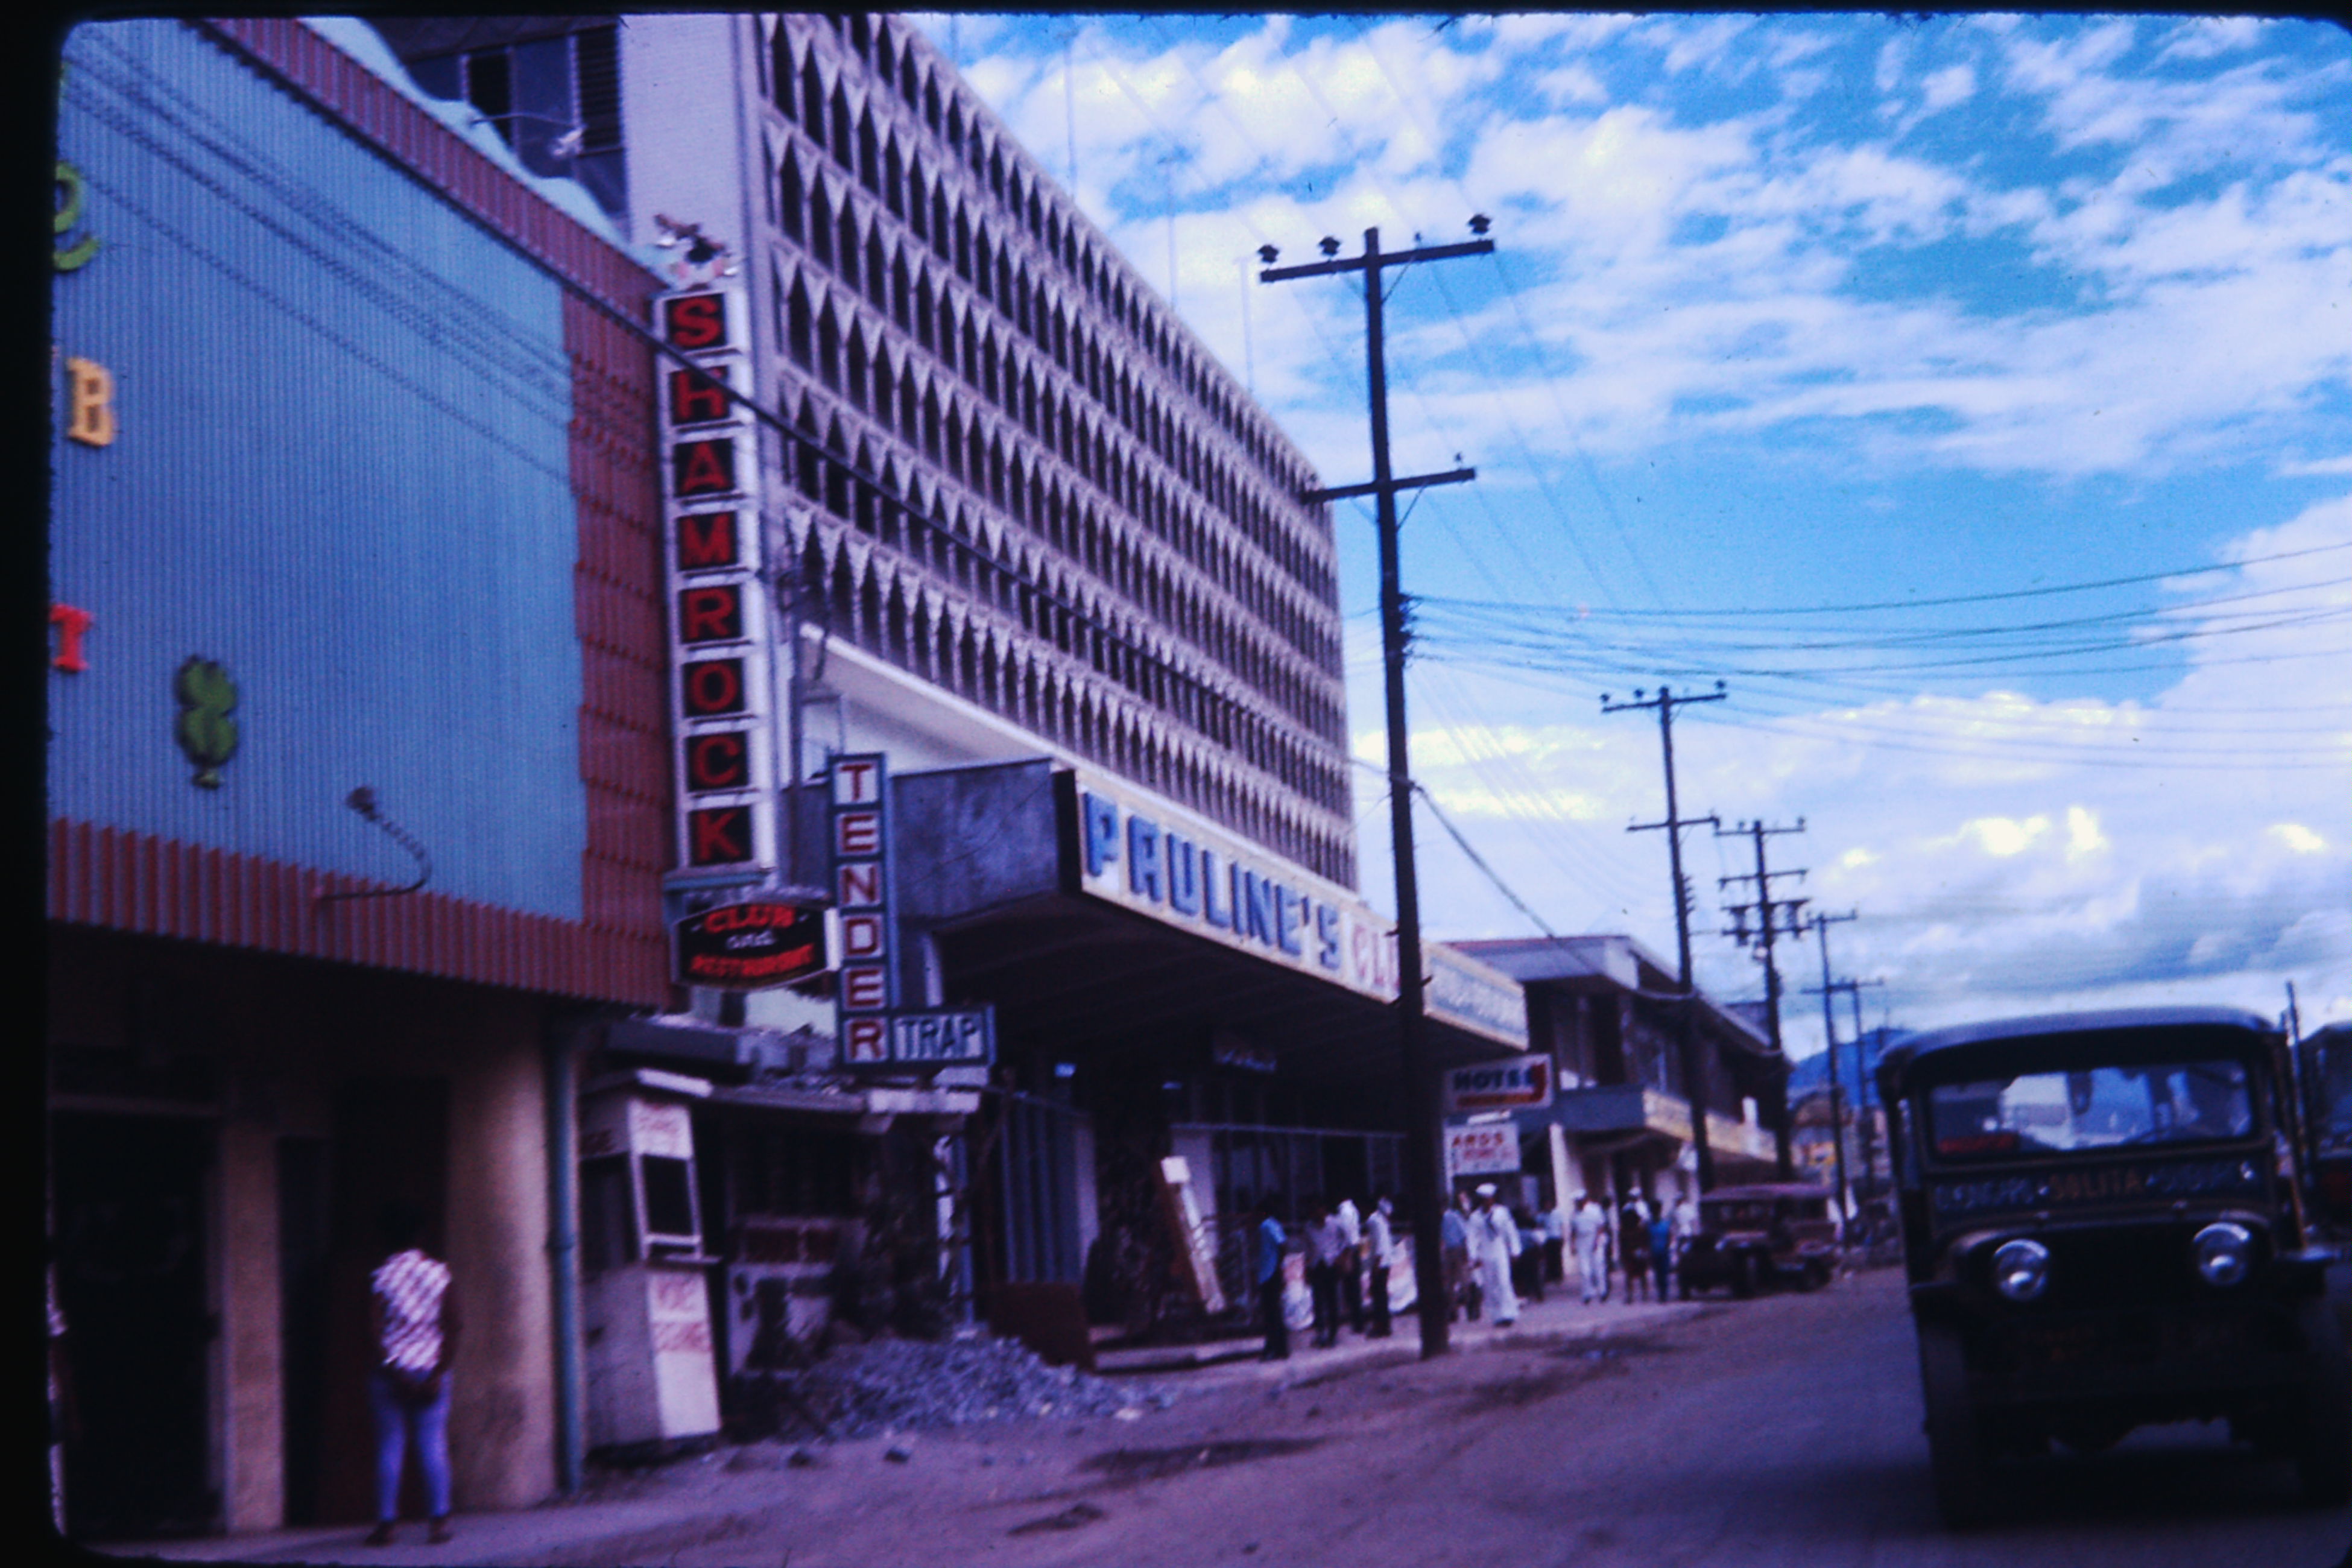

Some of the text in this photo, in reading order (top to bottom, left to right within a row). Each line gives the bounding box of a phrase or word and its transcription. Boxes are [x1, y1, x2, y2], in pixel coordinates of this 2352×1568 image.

[670, 297, 742, 861] SHAMROCK
[840, 763, 882, 1060] TENDER
[1083, 791, 1342, 970] PAULINE'S
[900, 1016, 978, 1059] TRAP
